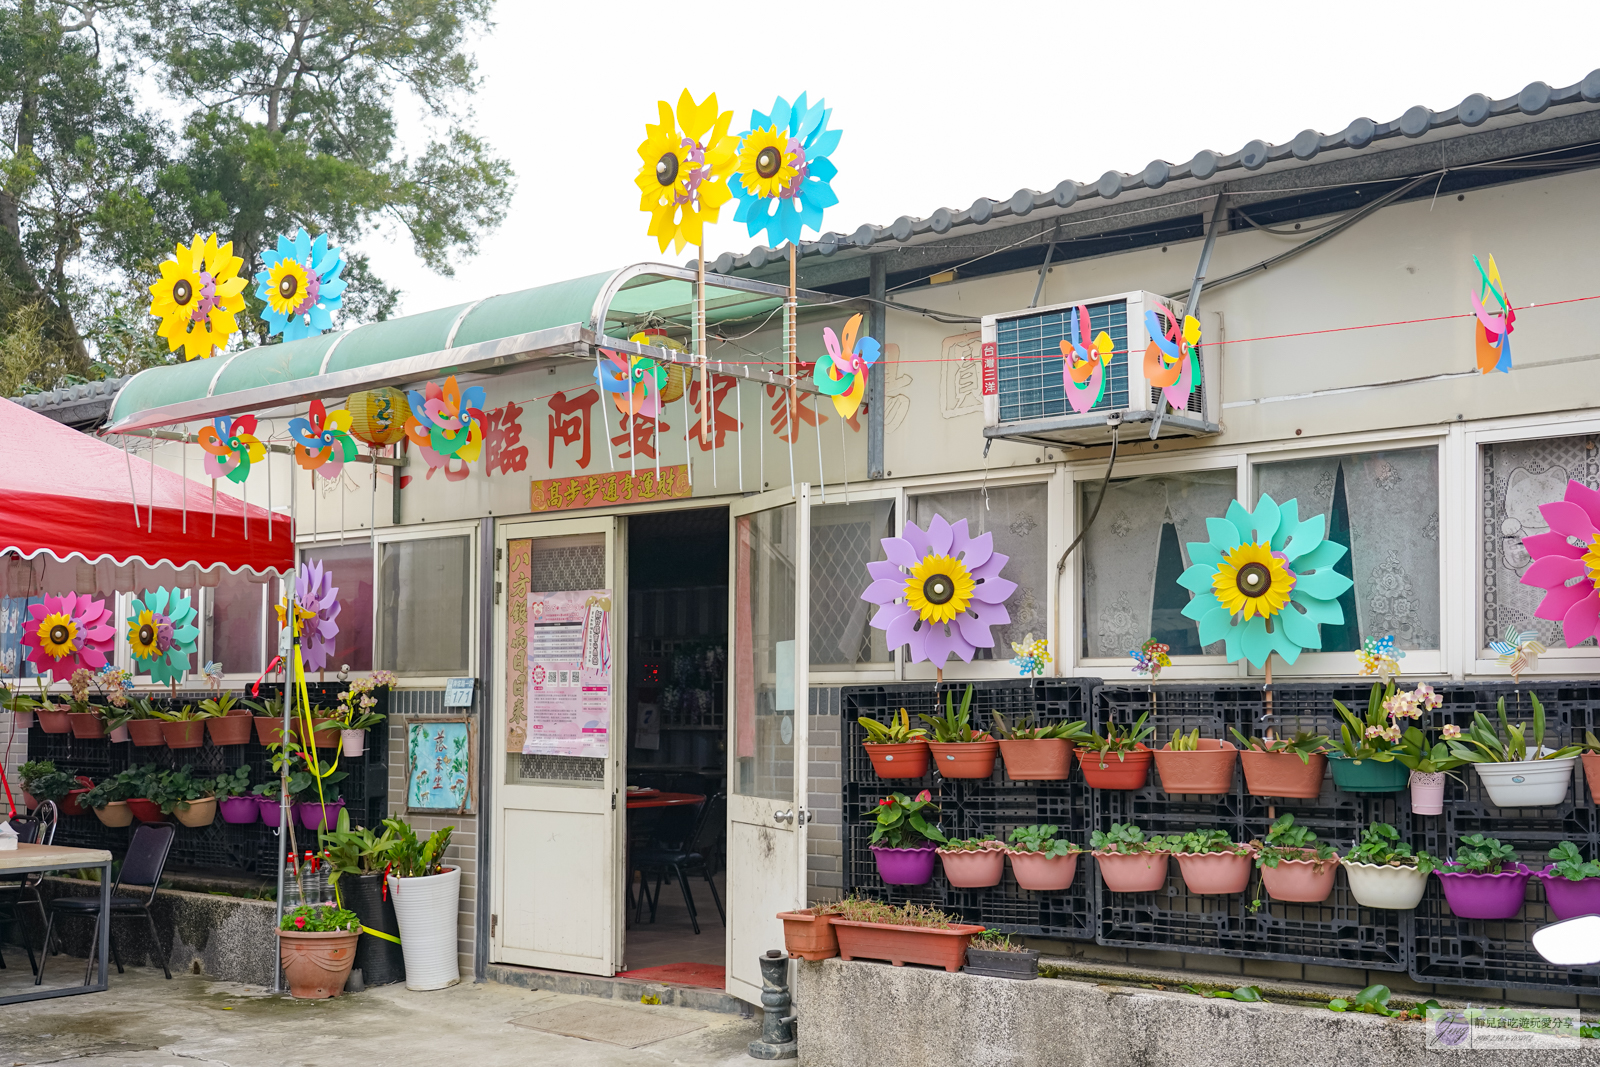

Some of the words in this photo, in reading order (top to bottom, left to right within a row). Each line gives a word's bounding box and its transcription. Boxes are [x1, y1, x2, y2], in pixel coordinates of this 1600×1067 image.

[984, 345, 996, 394] 台灣三洋
[452, 691, 471, 704] 171
